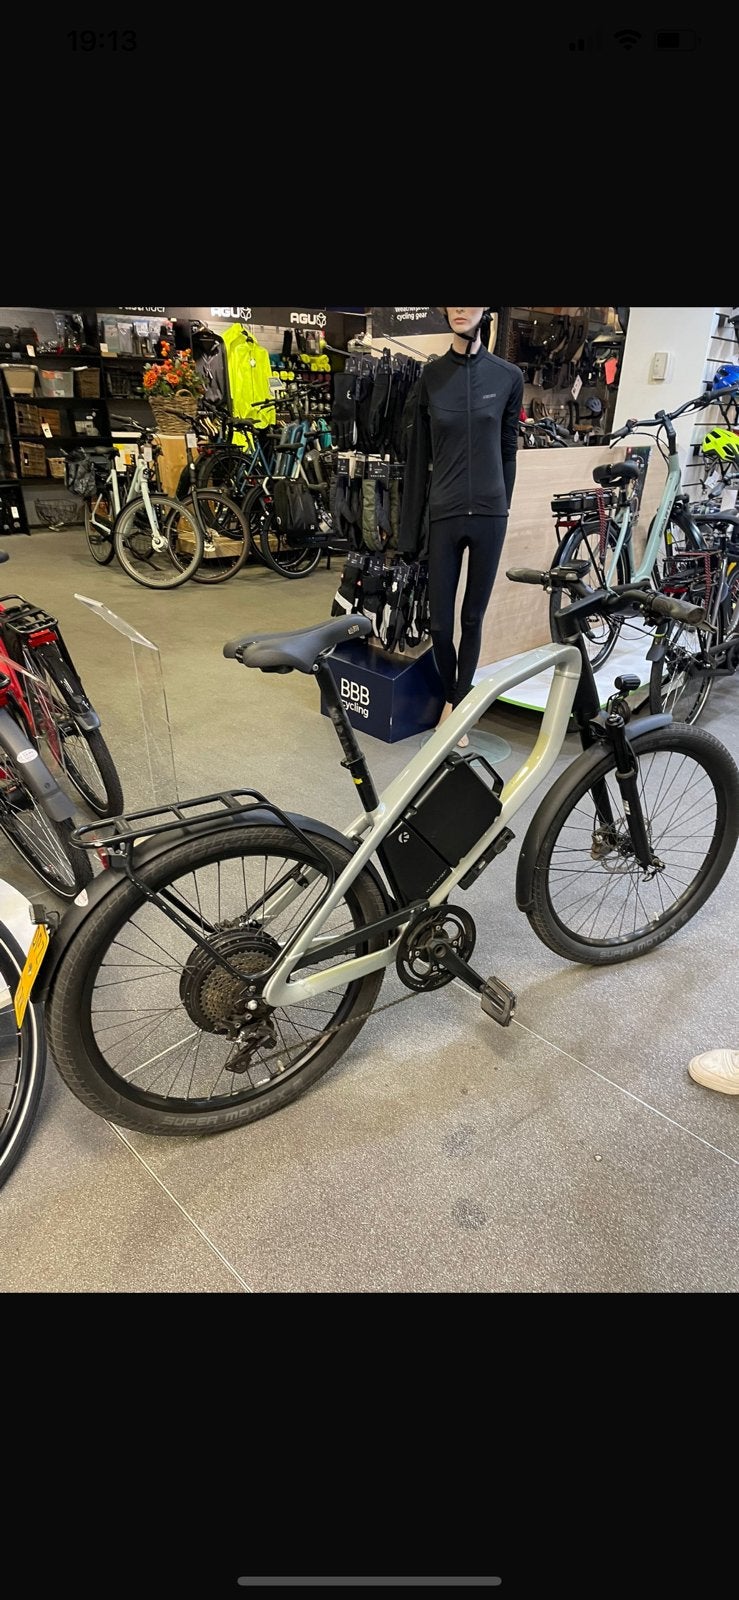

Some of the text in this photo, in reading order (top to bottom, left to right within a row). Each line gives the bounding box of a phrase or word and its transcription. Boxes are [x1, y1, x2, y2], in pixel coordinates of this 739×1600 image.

[210, 307, 240, 318] AGU
[396, 312, 428, 321] cycling gear
[290, 312, 317, 325] AGU
[340, 677, 370, 706] BBB
[600, 947, 634, 958] SUPER
[161, 1115, 219, 1127] SUPER
